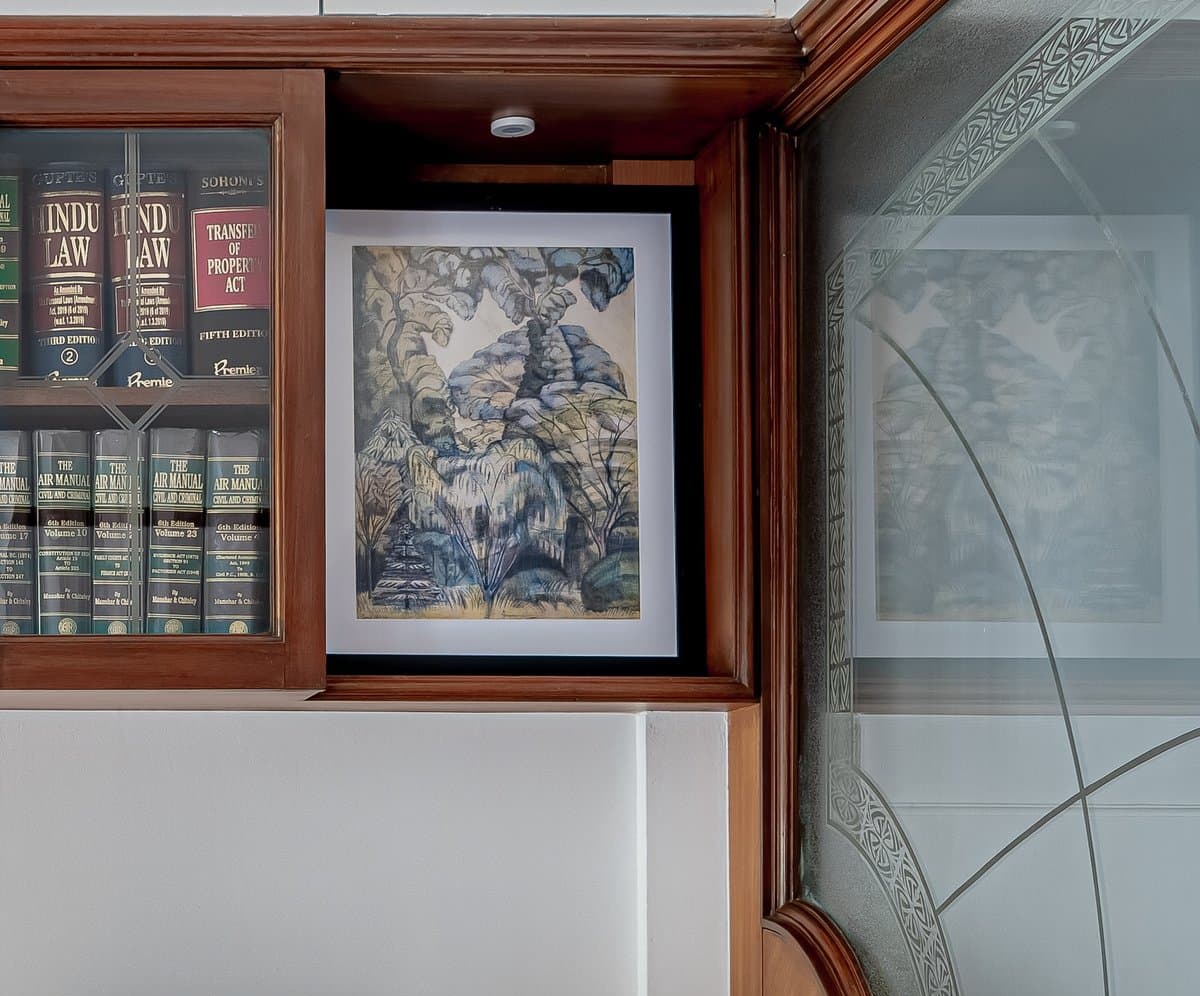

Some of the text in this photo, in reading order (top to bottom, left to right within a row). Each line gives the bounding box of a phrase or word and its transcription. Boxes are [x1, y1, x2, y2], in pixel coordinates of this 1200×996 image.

[207, 224, 256, 240] TRANSFE
[44, 236, 90, 268] LAW
[127, 237, 170, 269] LAW
[229, 242, 240, 255] OF
[226, 277, 245, 293] ACT
[200, 330, 229, 340] FIFTH
[66, 351, 73, 361] 2
[58, 461, 73, 470] THE
[109, 463, 126, 474] THE
[170, 460, 188, 472] THE
[233, 465, 250, 474] THE
[0, 477, 30, 490] MANUAL
[39, 474, 90, 486] AIR MANUAL
[96, 476, 108, 489] AIR
[154, 473, 203, 489] AIR MANUAL
[214, 479, 228, 490] AIR
[39, 491, 52, 499] CIVIL
[95, 494, 118, 504] CIVIL AND
[153, 492, 202, 503] CIVIL AND CRIMINAL
[213, 496, 228, 504] CIVIL
[45, 529, 75, 537] Volume
[96, 531, 126, 539] Volume
[155, 529, 197, 537] Volume 23
